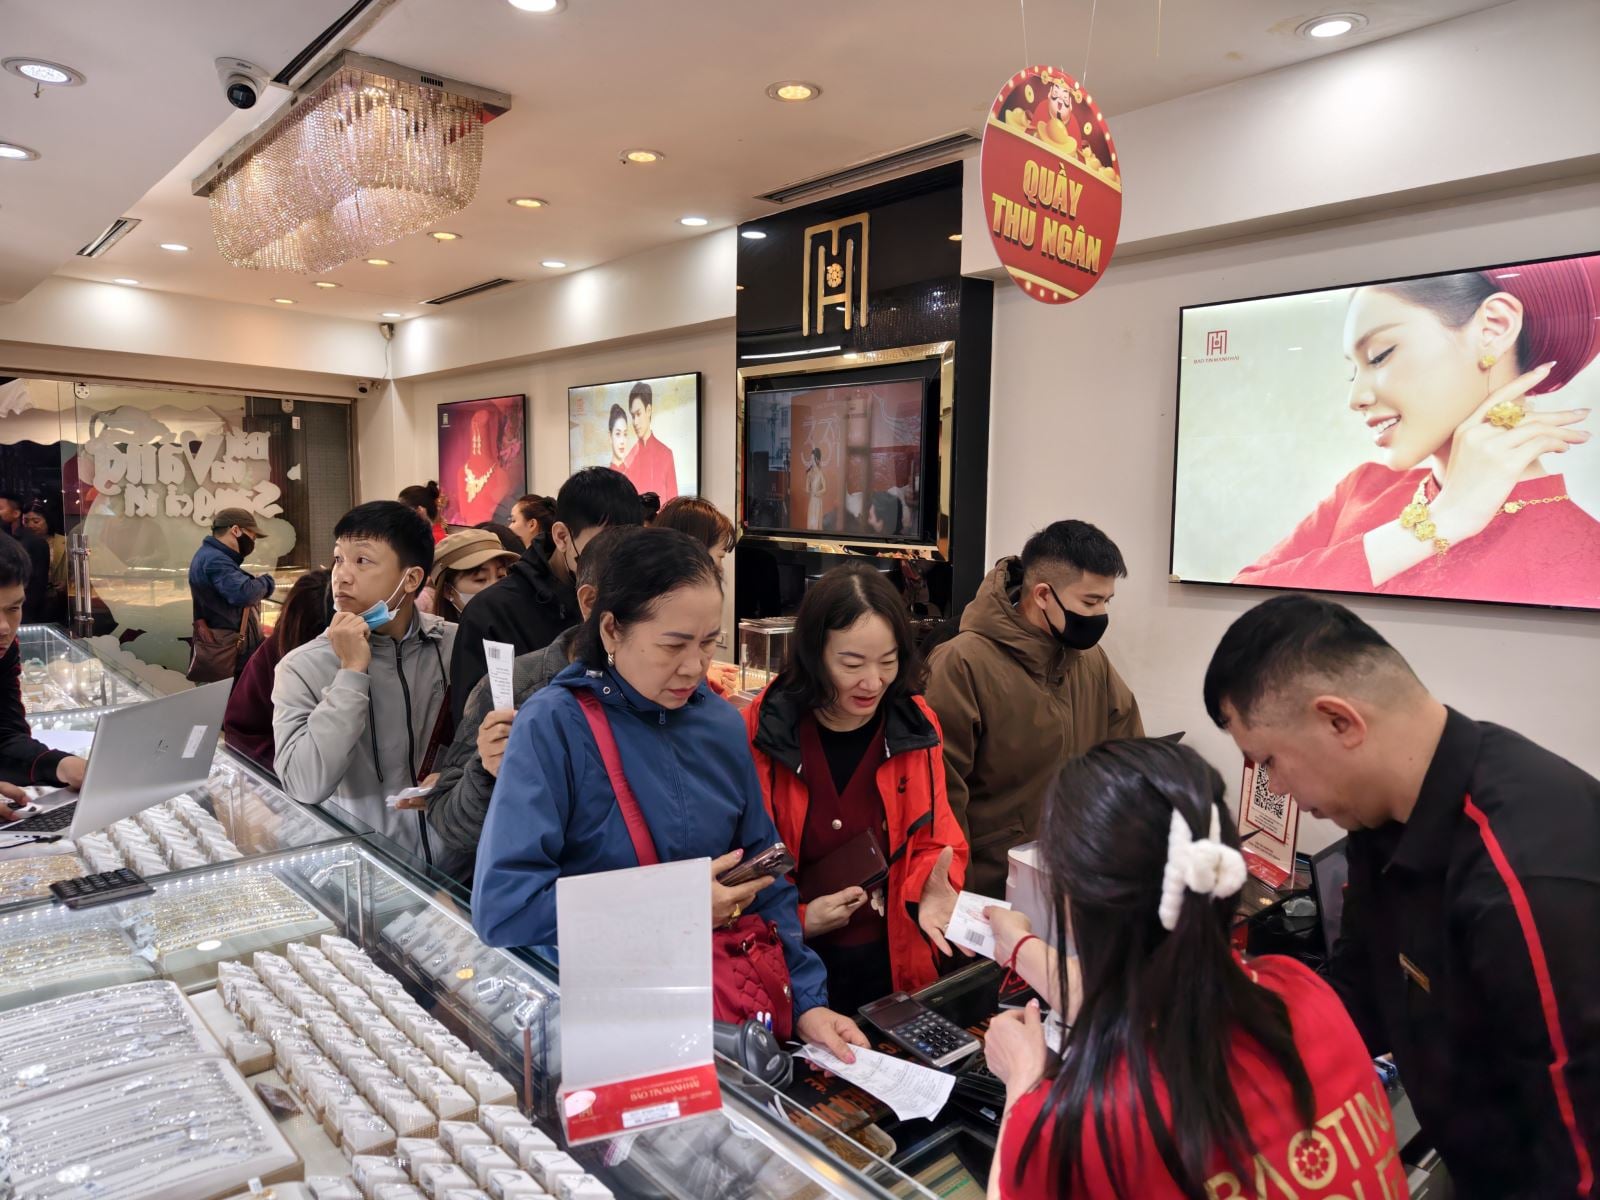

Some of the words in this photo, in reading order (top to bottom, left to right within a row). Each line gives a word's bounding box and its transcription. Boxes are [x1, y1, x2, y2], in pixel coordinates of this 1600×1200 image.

[1022, 159, 1083, 219] QUẦY
[992, 193, 1037, 247] THU
[1041, 217, 1102, 274] NGÂN
